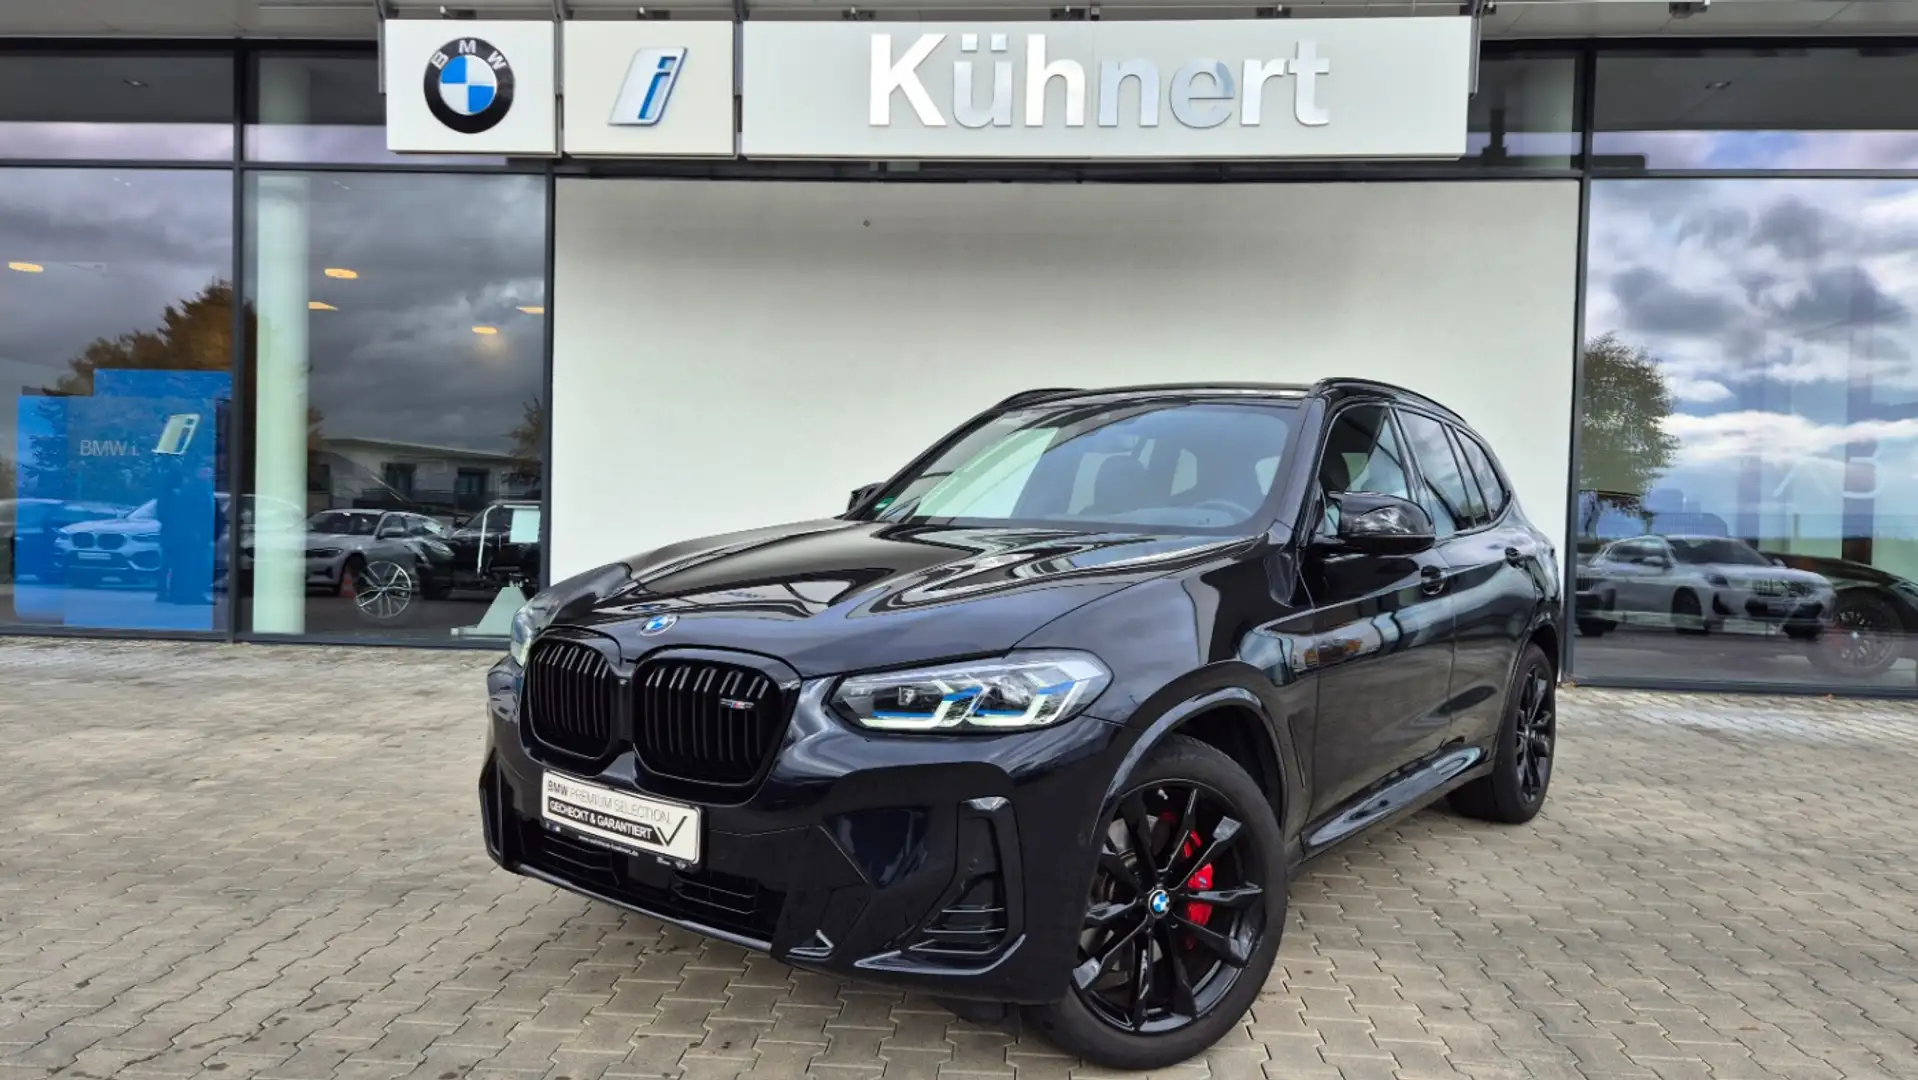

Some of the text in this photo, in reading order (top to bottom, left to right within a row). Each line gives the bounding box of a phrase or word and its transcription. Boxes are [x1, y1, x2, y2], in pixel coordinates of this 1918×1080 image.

[430, 39, 507, 71] BMW
[869, 33, 1330, 128] Kühnert
[80, 439, 127, 457] BMW
[548, 779, 569, 797] BMW
[570, 787, 613, 810] PREMIUM
[550, 800, 653, 840] GECHECKT & GARANTIERT
